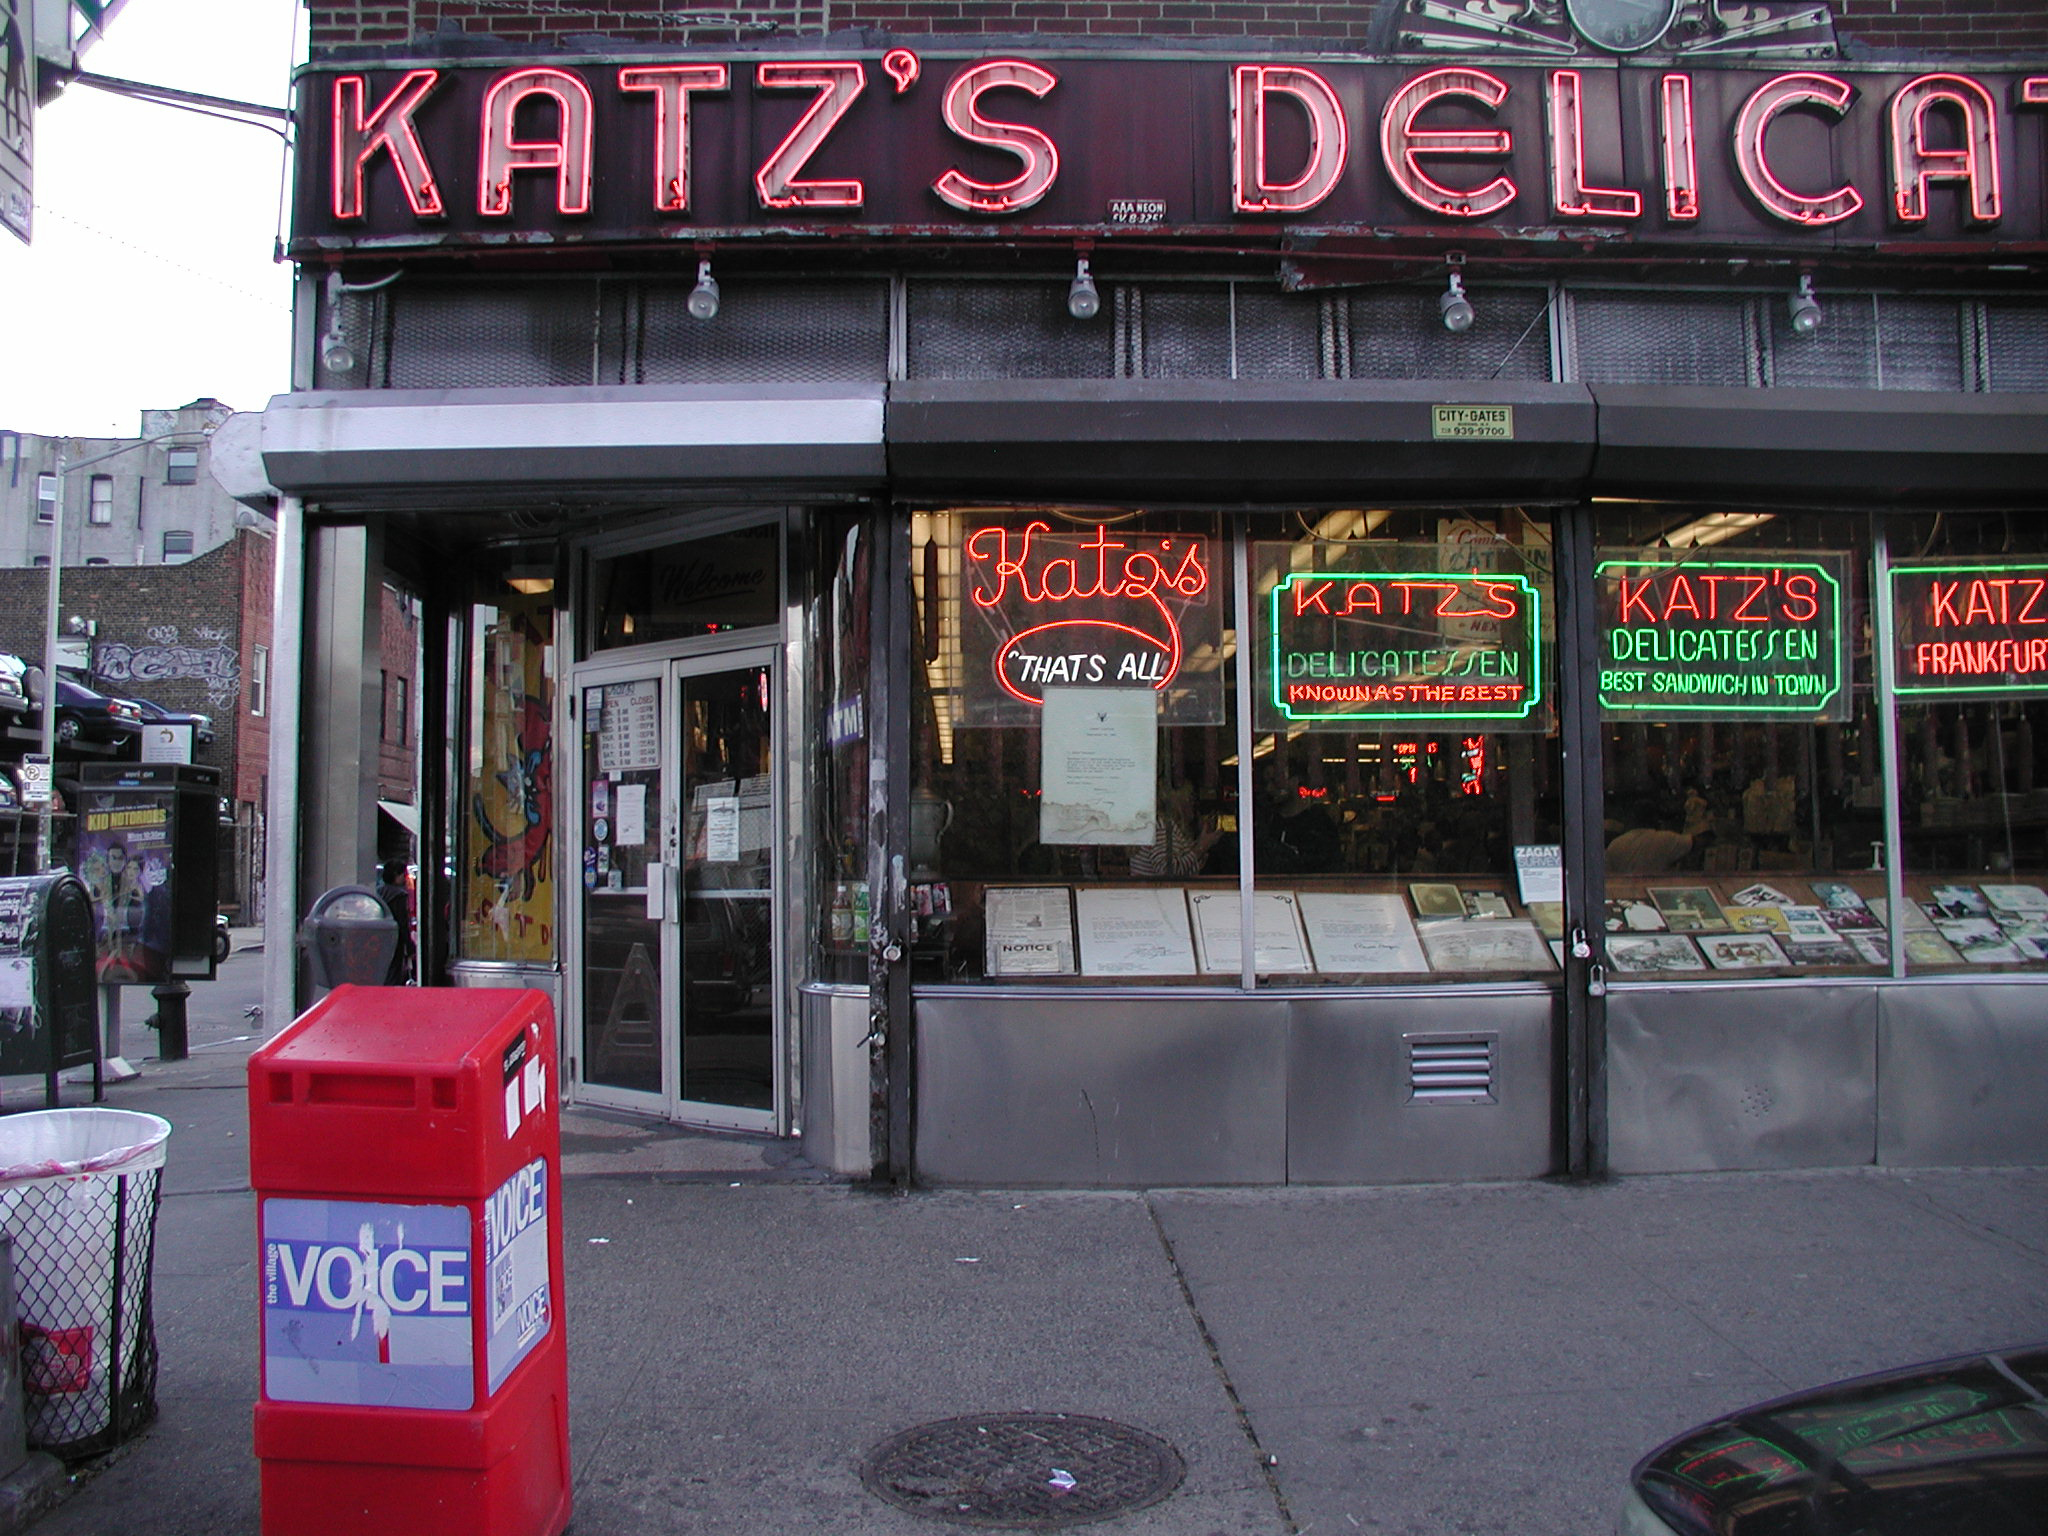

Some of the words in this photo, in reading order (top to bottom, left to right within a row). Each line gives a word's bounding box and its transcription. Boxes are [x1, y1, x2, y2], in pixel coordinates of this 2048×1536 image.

[330, 48, 1062, 220] KATZ'S
[1229, 63, 2048, 228] DELICA
[1112, 202, 1135, 213] AAA
[1136, 203, 1163, 213] NEON
[658, 556, 767, 602] Welcome
[967, 521, 1207, 608] Katz's
[1294, 567, 1517, 619] KATZ'S
[1620, 568, 1820, 624] KATZ'S
[1611, 628, 1818, 663] DELICATESSEN
[1916, 638, 2048, 676] FRANKFUR
[1116, 652, 1164, 682] ALL
[1286, 649, 1520, 678] DELICATESSEN
[1289, 684, 1374, 703] KNOWN
[1374, 684, 1406, 702] AS
[1408, 685, 1455, 703] THE
[1457, 684, 1525, 702] BEST
[1600, 670, 1646, 693] BEST
[1651, 672, 1747, 697] SANDWICH
[1751, 674, 1769, 695] IN
[1773, 674, 1827, 696] TOWN
[124, 771, 155, 779] verion
[87, 812, 109, 832] KID
[1516, 846, 1560, 858] ZAGAT
[1003, 944, 1053, 952] NOTICE
[487, 1158, 543, 1258] VOICE
[266, 1242, 278, 1285] village
[276, 1243, 469, 1313] VOICE
[266, 1287, 278, 1305] the
